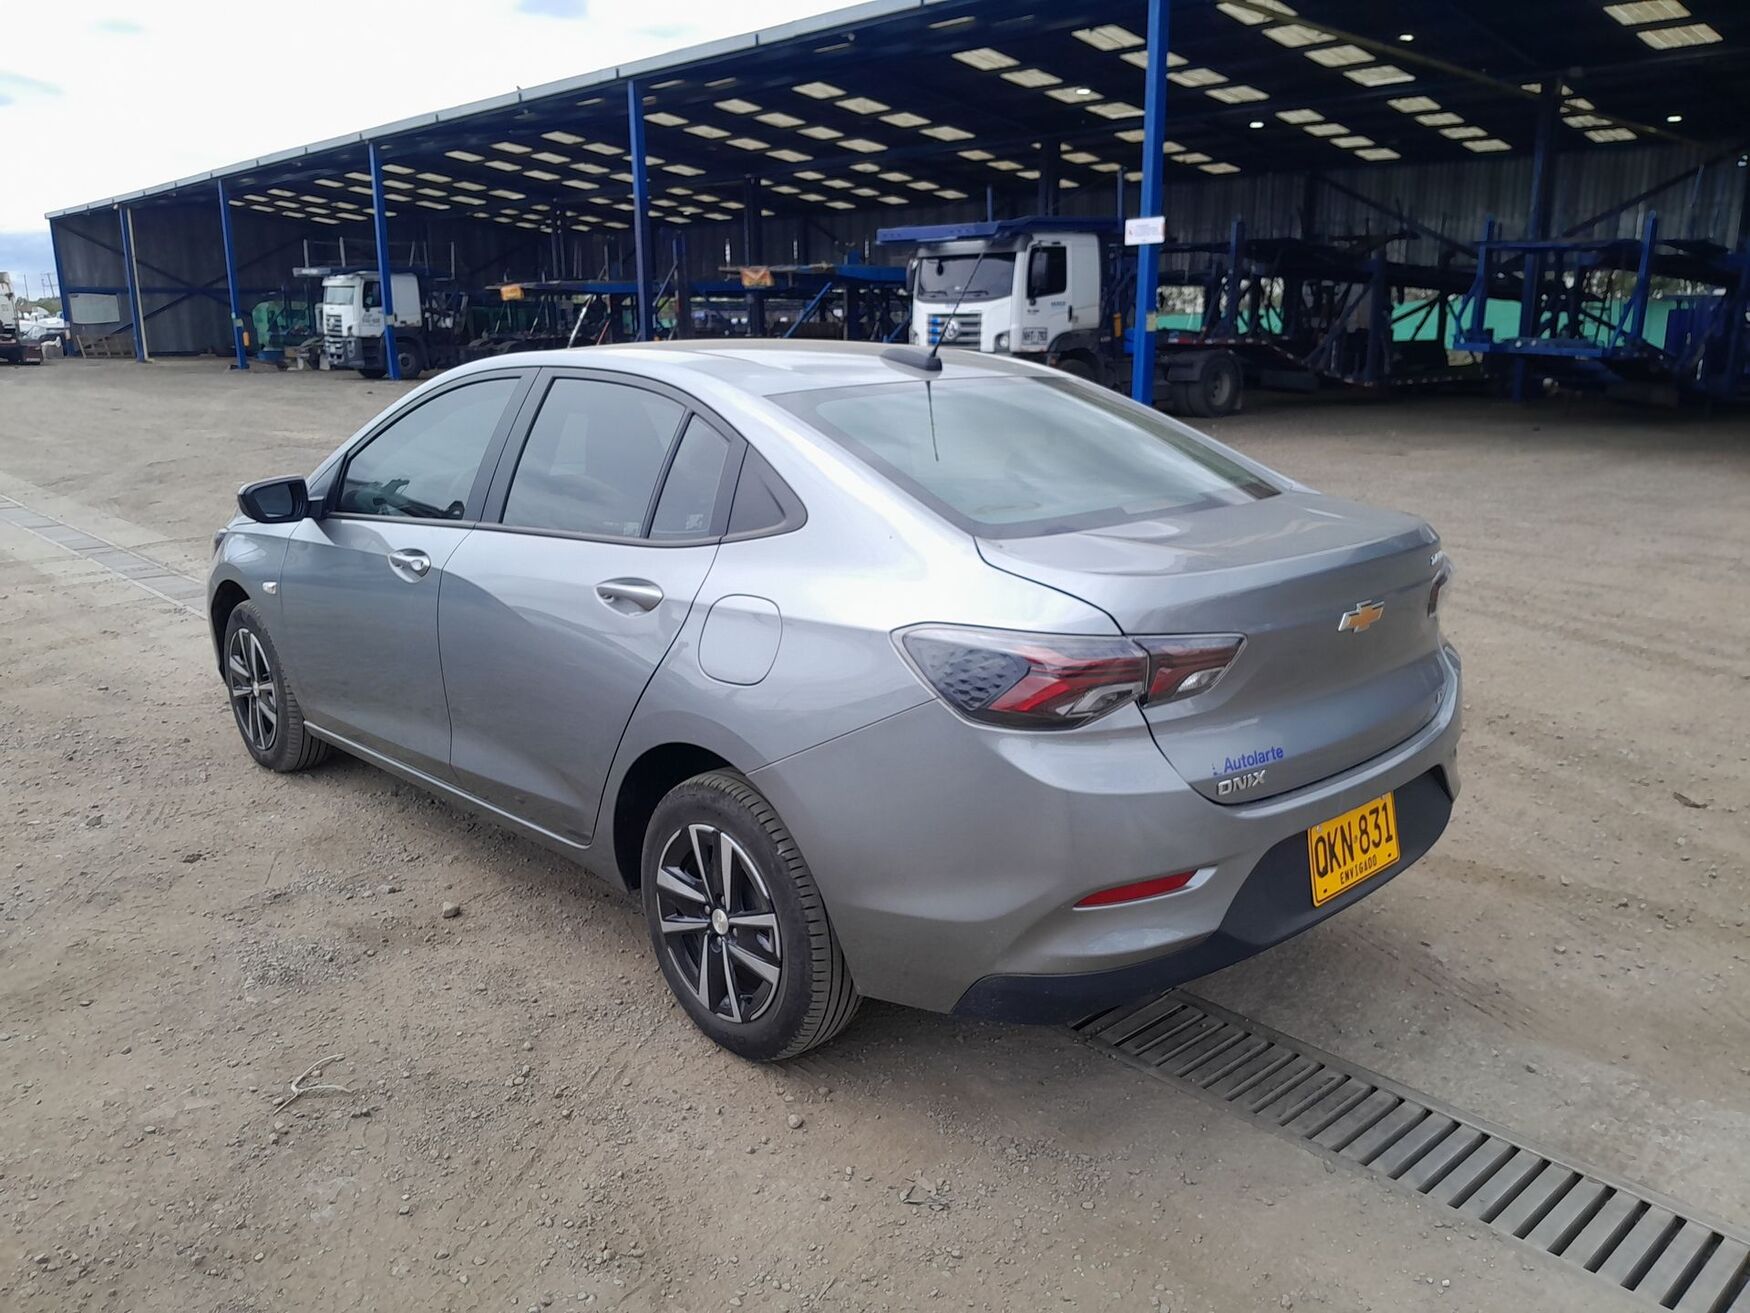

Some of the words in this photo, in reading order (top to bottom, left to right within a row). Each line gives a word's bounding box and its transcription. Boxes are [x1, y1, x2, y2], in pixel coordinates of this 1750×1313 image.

[1224, 746, 1284, 773] Autolarte
[1217, 769, 1266, 796] ONIX
[1340, 854, 1377, 885] ENVIGADO
